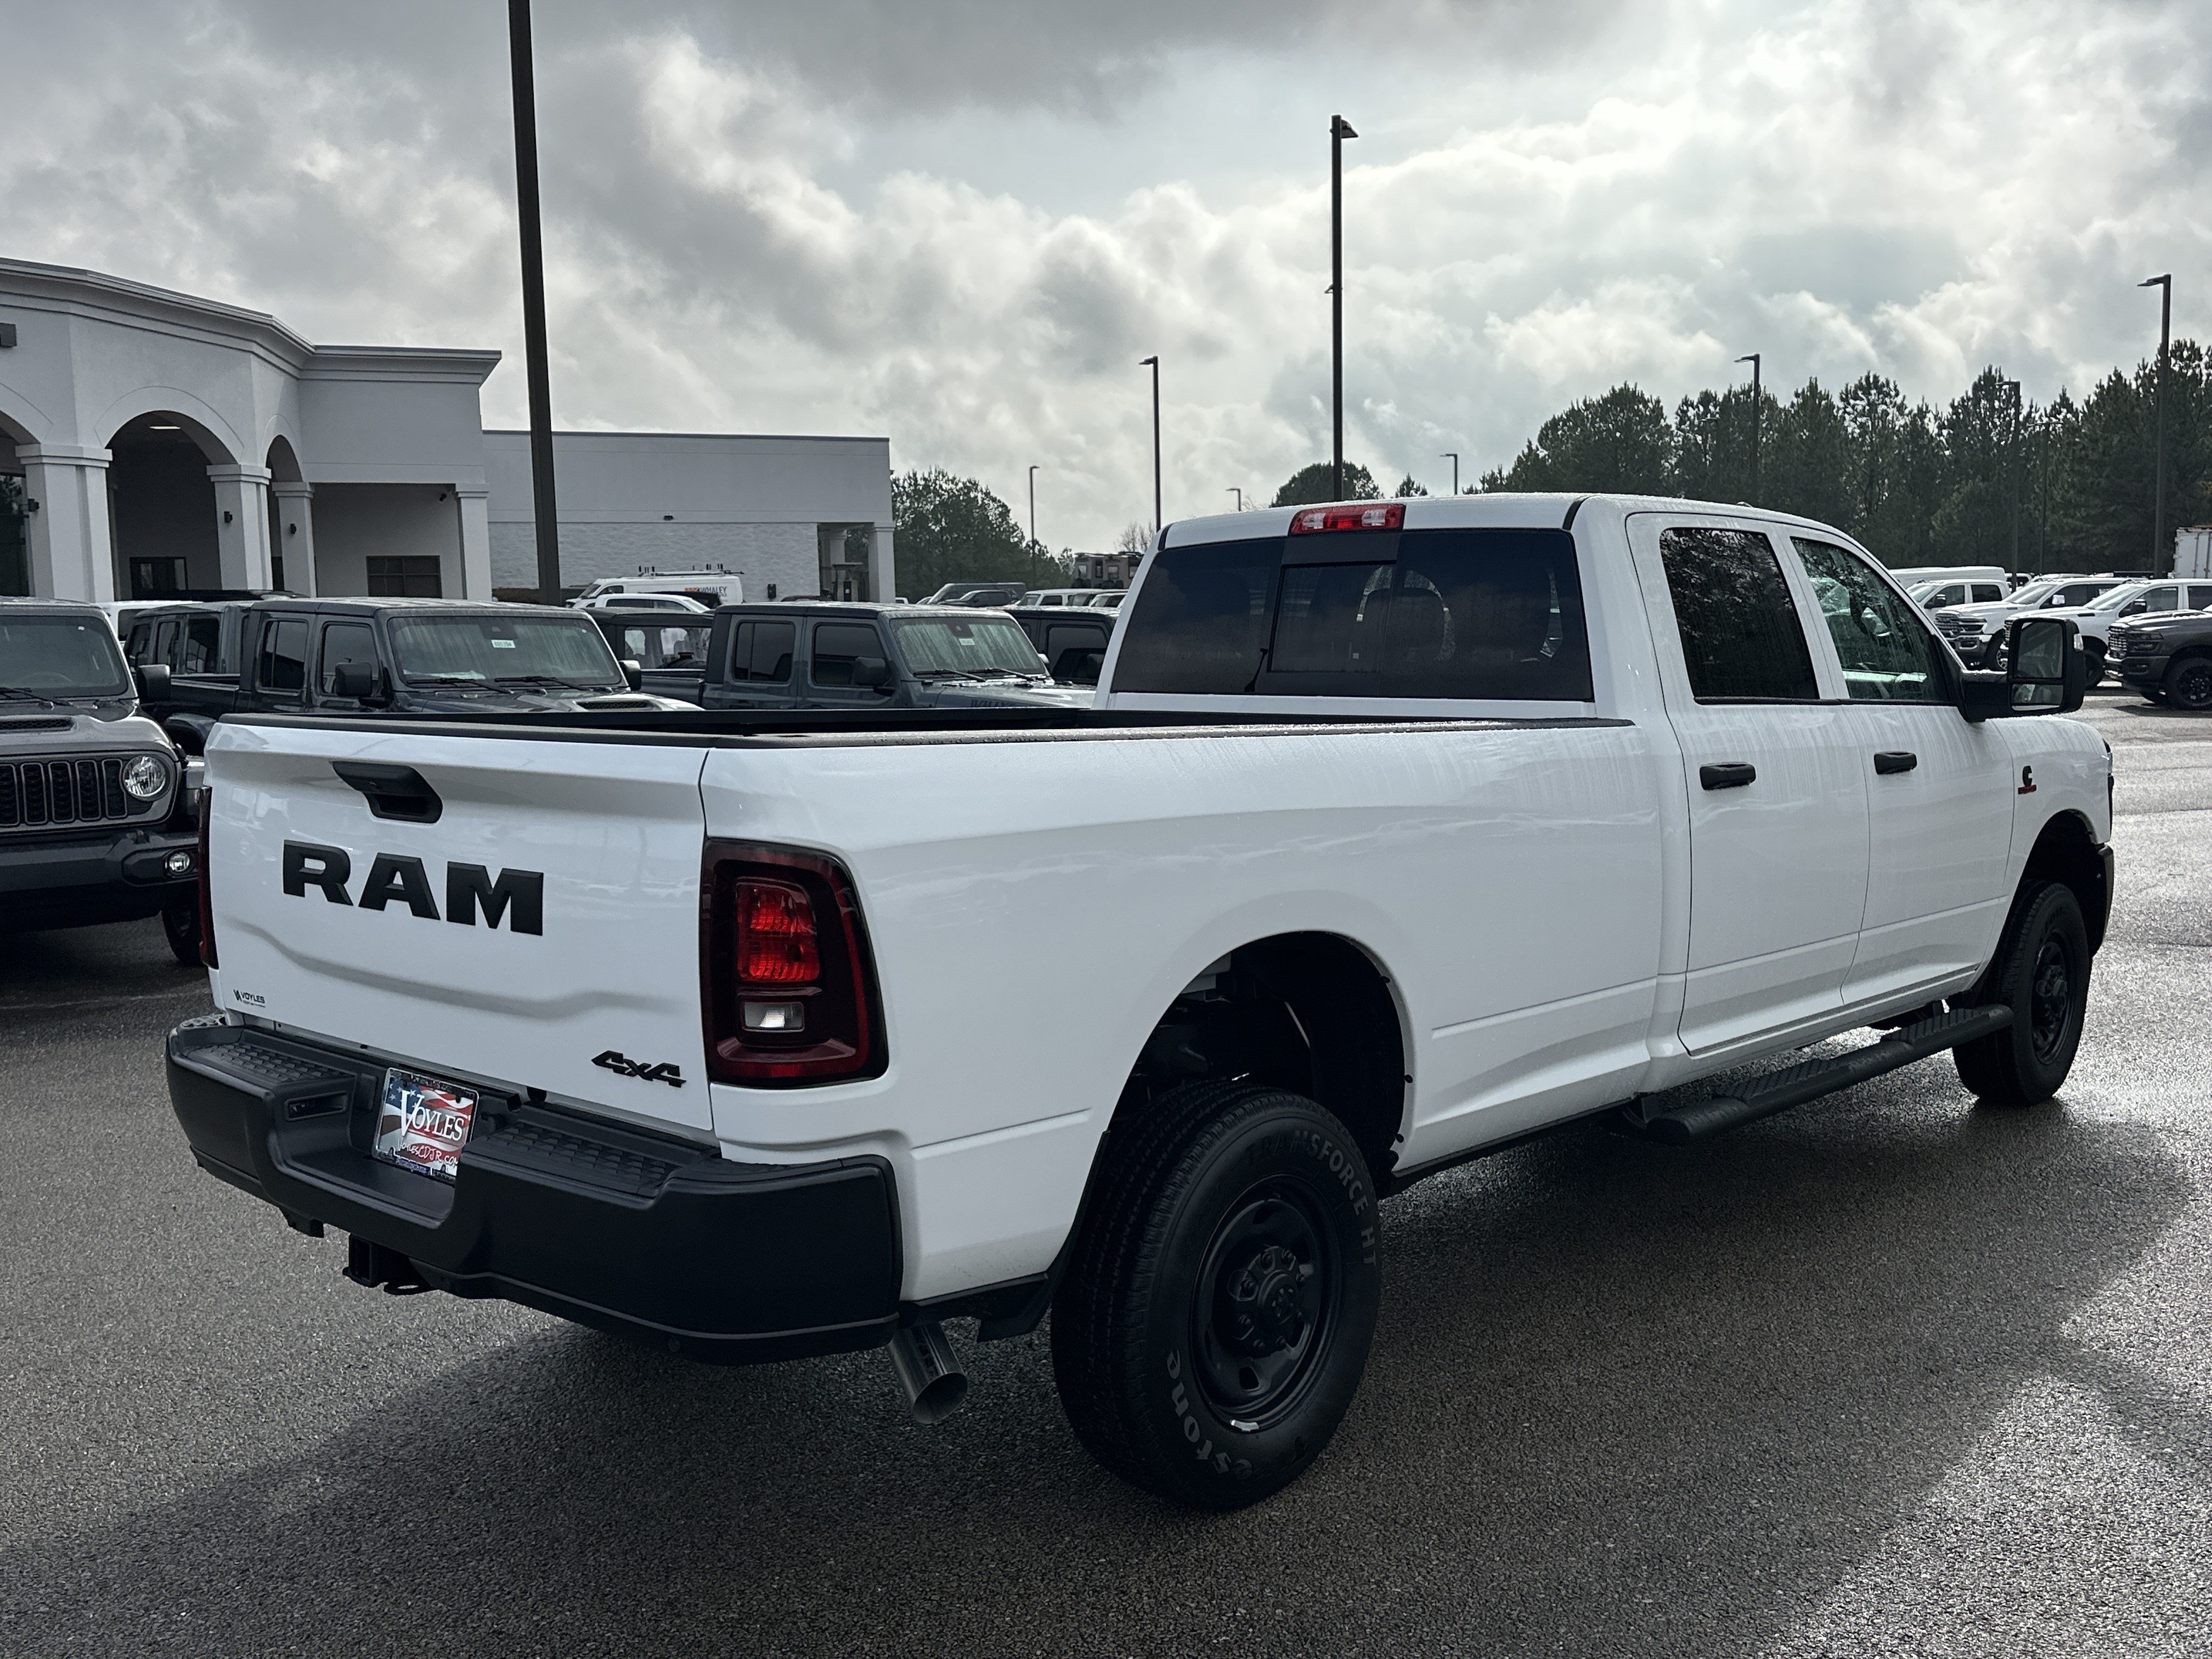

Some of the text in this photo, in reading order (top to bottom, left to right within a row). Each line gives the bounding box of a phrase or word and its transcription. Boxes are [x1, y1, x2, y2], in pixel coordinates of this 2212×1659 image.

[282, 839, 544, 936] RAM
[240, 991, 266, 1003] VOYLES
[400, 1089, 465, 1141] VOYLES
[1360, 1226, 1377, 1267] HT
